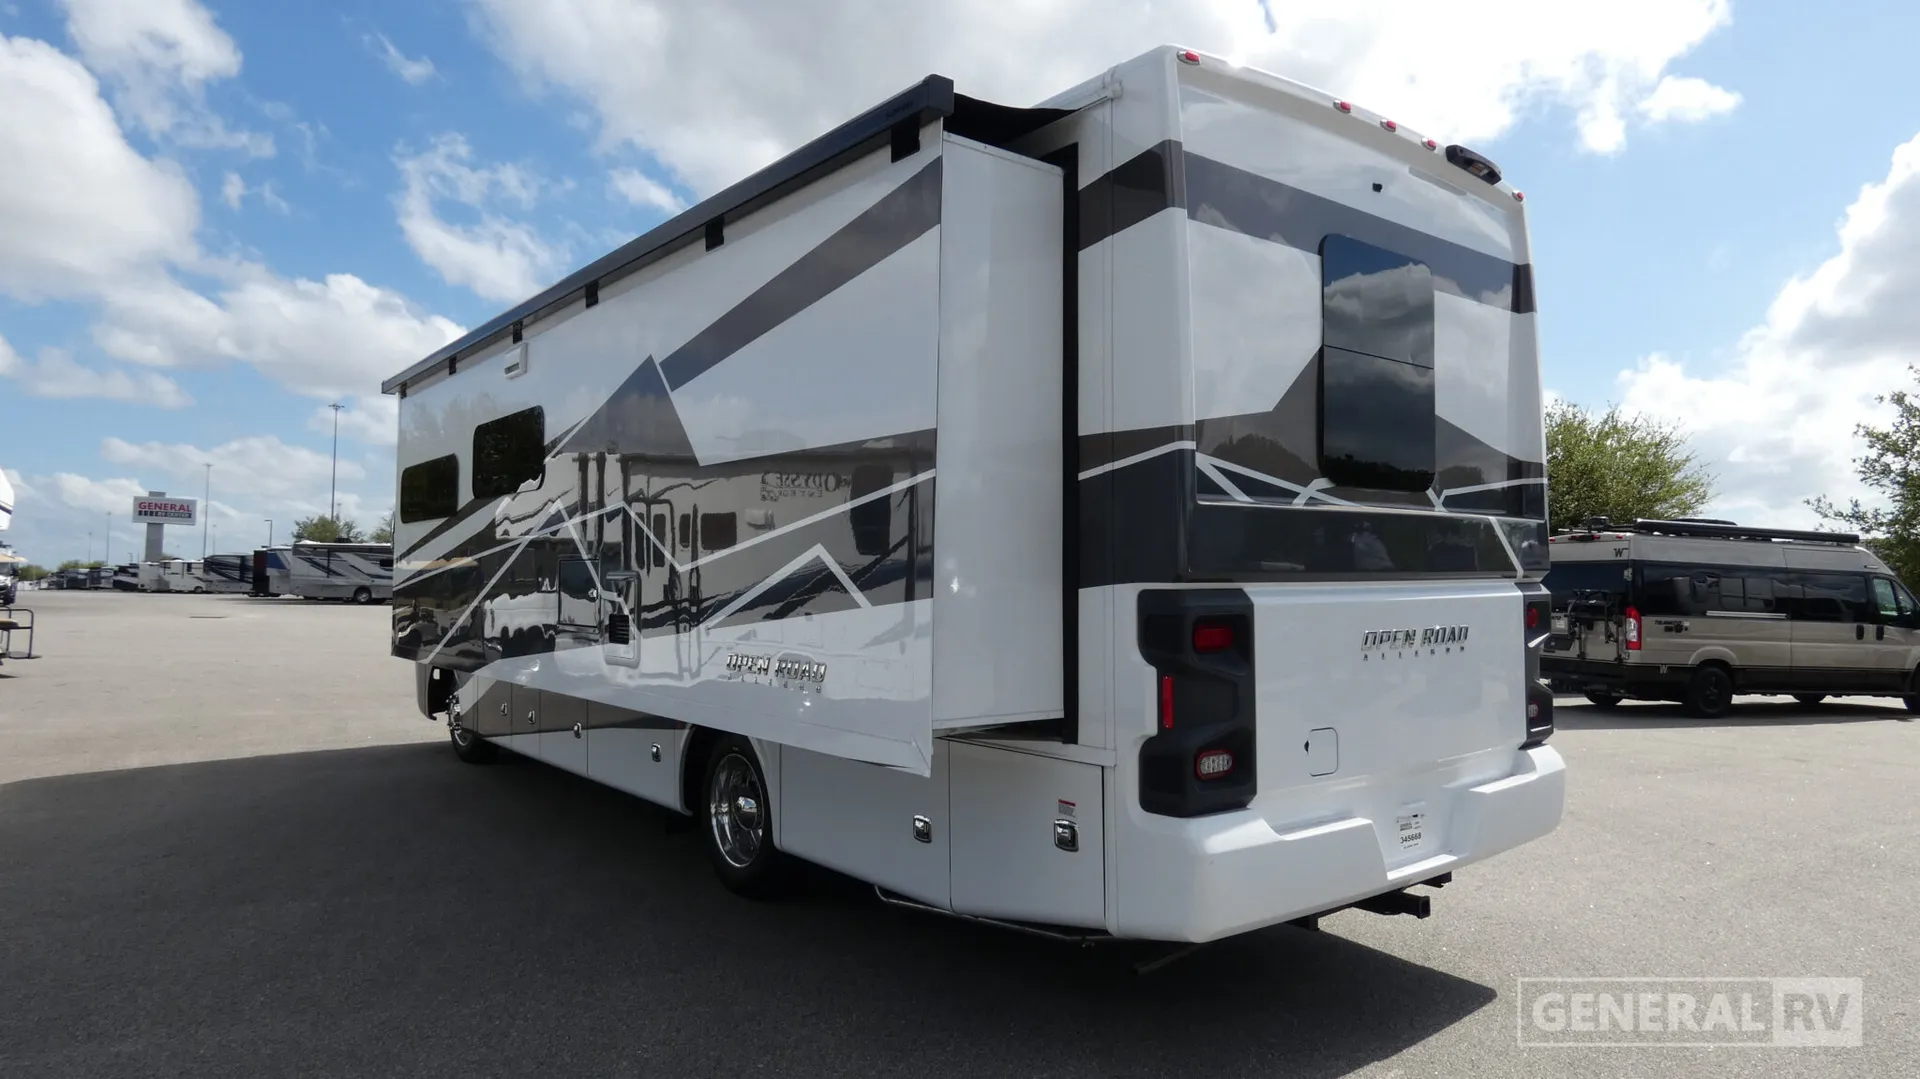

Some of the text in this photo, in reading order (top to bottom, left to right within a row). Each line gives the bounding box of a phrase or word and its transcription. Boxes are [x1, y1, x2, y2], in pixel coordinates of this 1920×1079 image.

[138, 501, 192, 512] GENERAL
[1361, 624, 1469, 651] OPEN ROAD
[726, 653, 827, 683] OPEN ROAD
